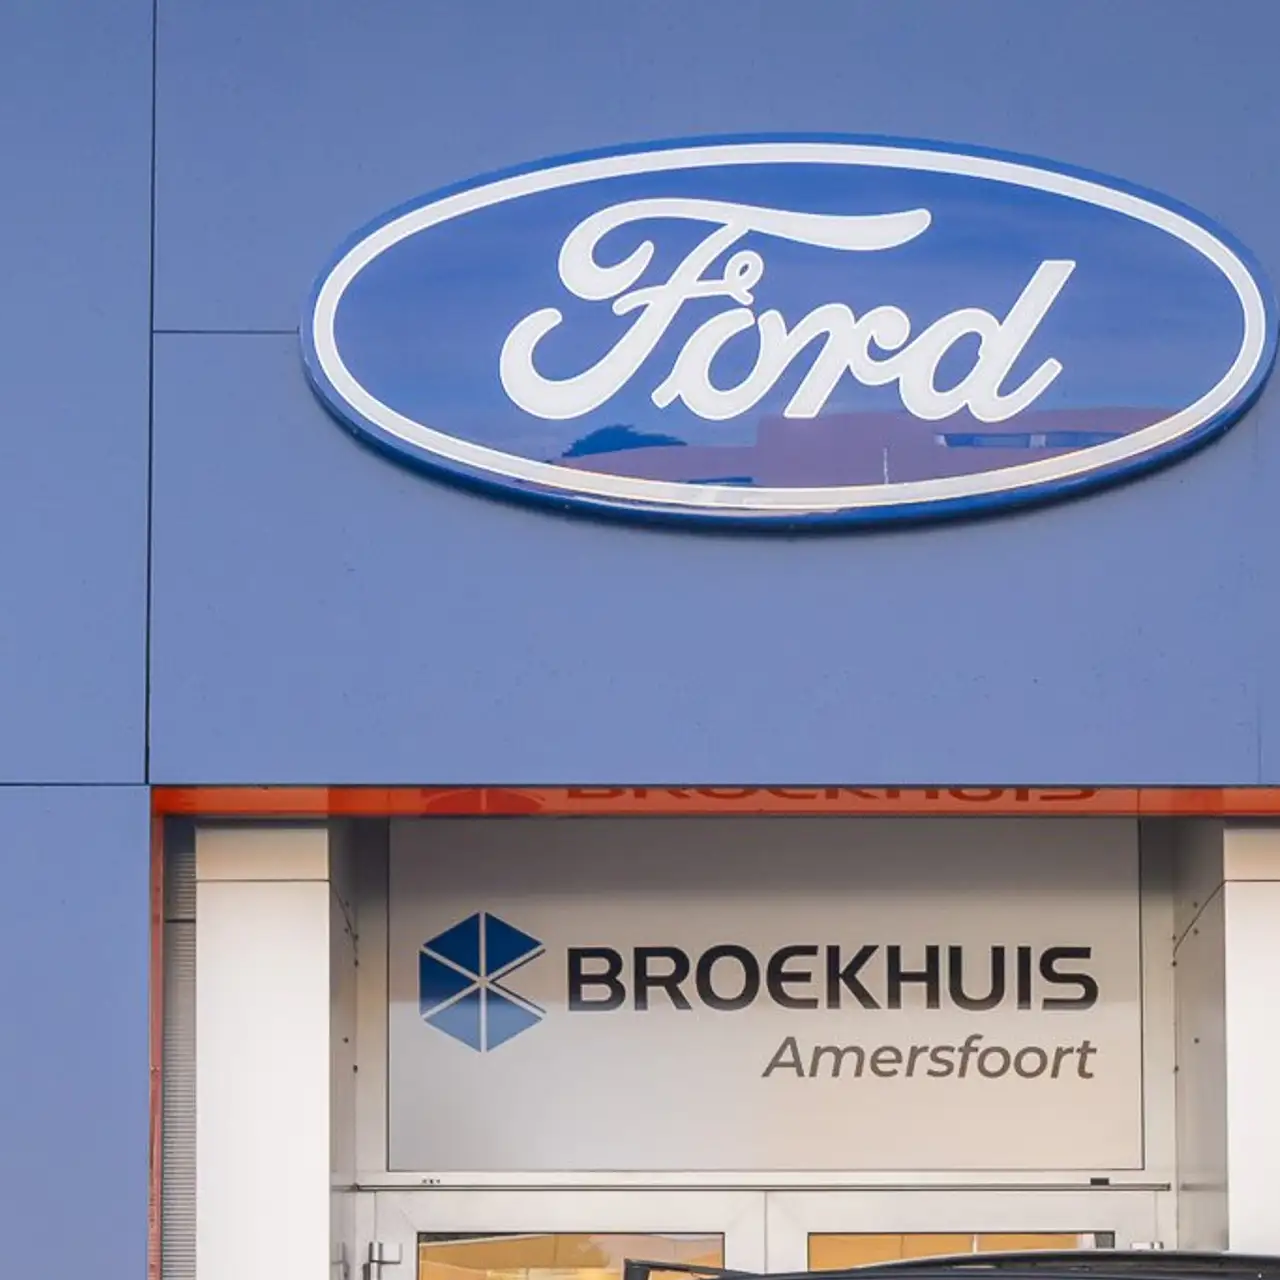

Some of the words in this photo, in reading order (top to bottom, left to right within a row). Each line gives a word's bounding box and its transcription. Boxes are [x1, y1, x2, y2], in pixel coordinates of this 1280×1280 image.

[499, 198, 1076, 423] Ford
[567, 944, 1099, 1011] BROEKHUIS
[761, 1033, 1098, 1080] Amersfoort
